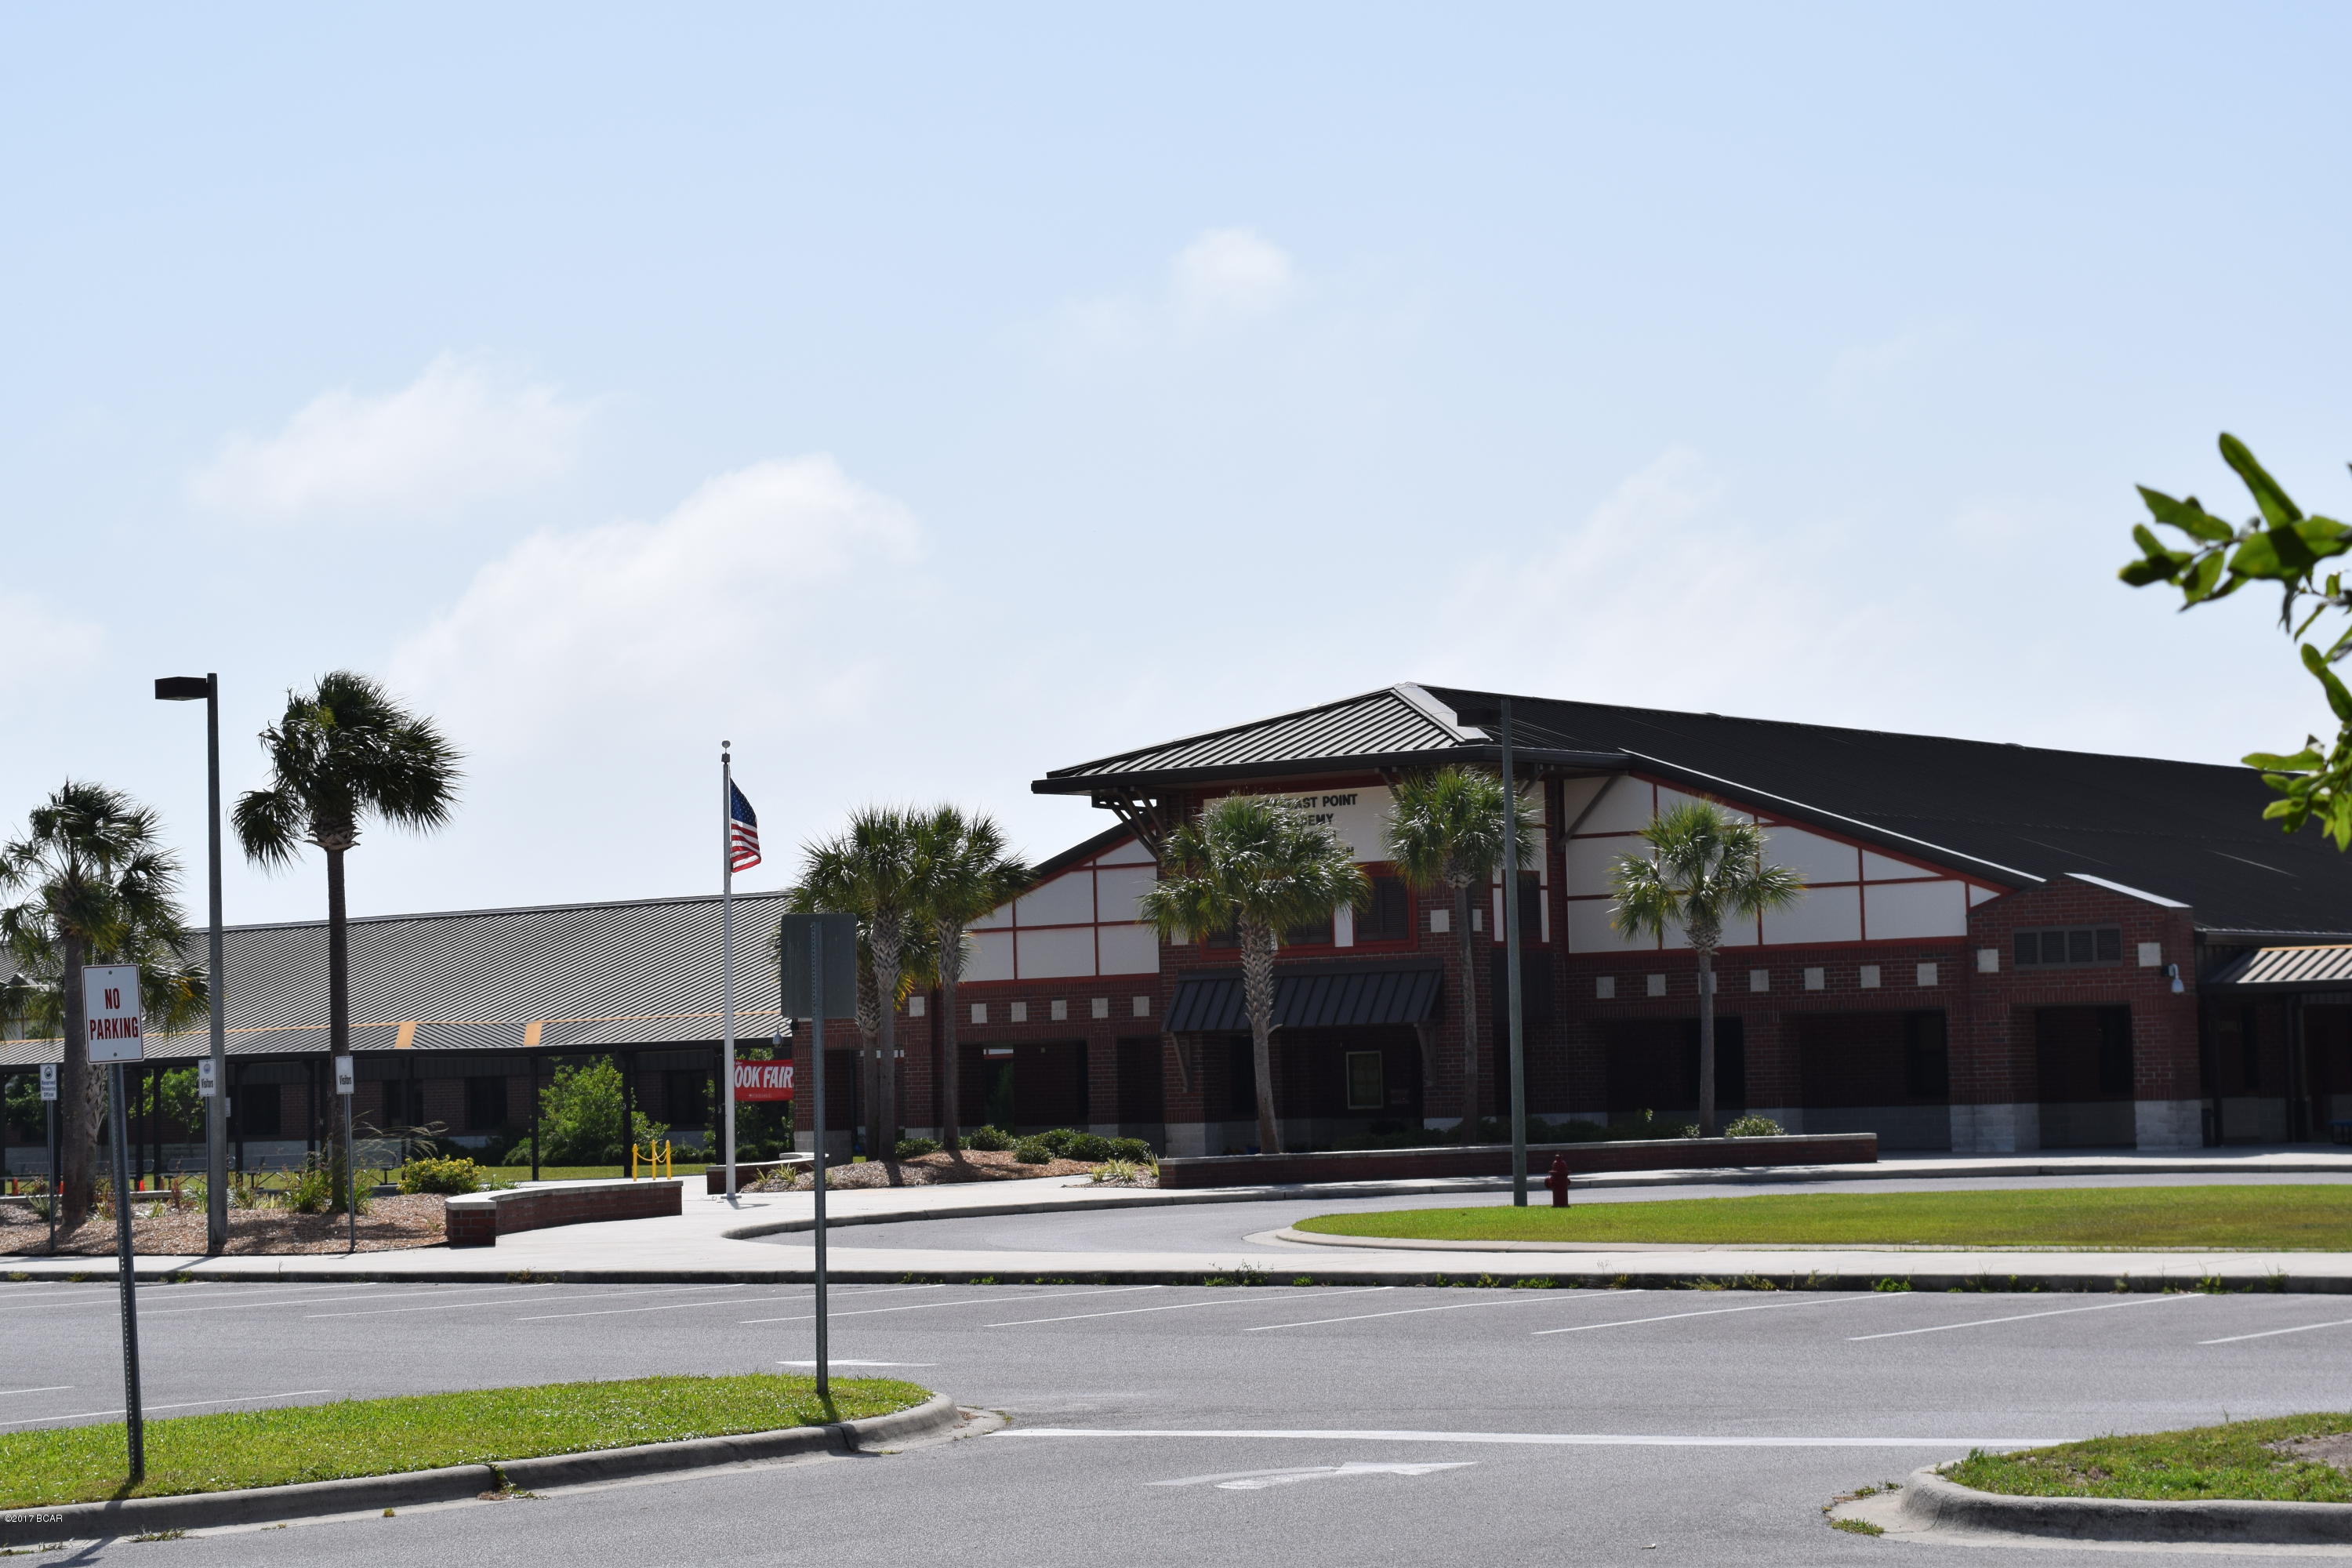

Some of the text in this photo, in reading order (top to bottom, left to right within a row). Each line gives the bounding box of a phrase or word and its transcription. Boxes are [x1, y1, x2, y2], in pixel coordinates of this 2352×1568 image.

[1323, 793, 1358, 808] POINT
[104, 988, 120, 1009] NO
[89, 1016, 139, 1040] PARKING
[734, 1065, 762, 1088] OOK
